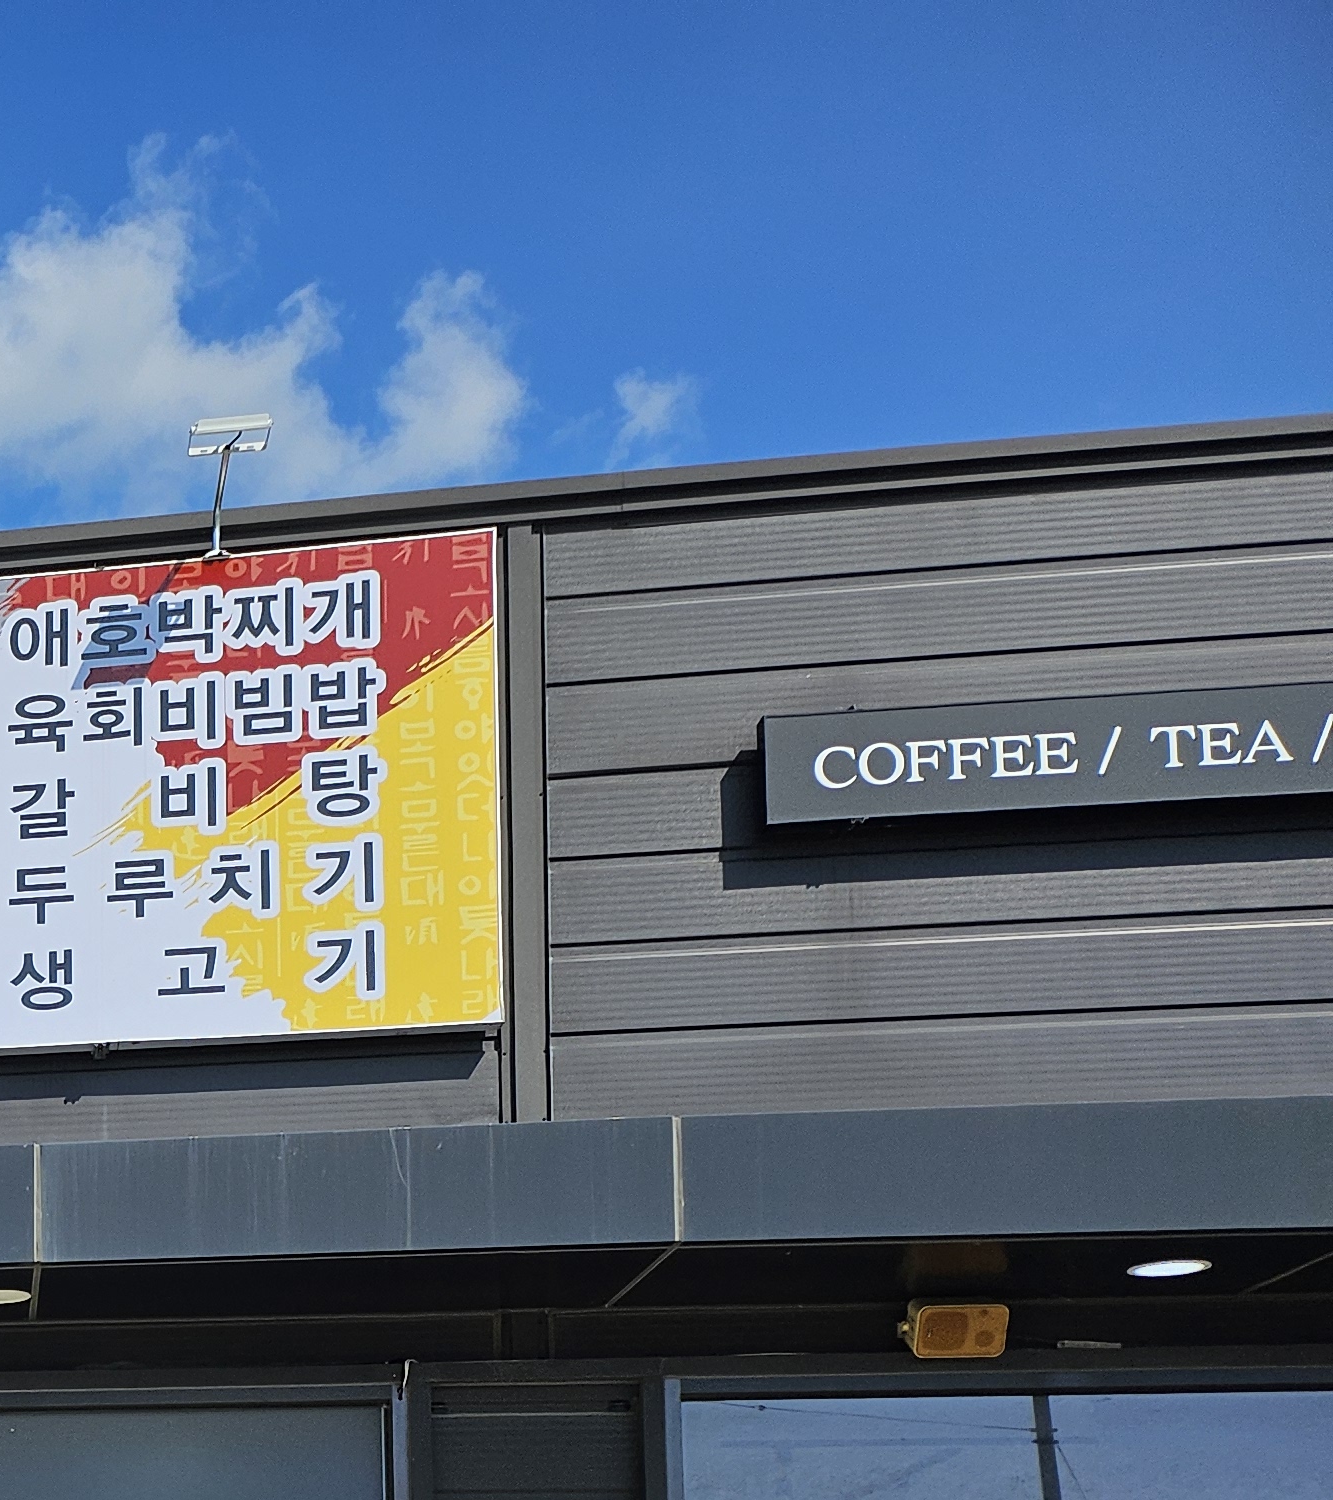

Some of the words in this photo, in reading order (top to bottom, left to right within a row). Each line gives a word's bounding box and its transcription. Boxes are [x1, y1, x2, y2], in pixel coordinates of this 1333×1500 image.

[9, 577, 375, 667] 애호박찌개
[8, 666, 376, 751] 육회비빔밥
[814, 731, 1079, 790] COFFEE
[1150, 719, 1293, 768] TEA
[8, 841, 375, 925] 두루치기
